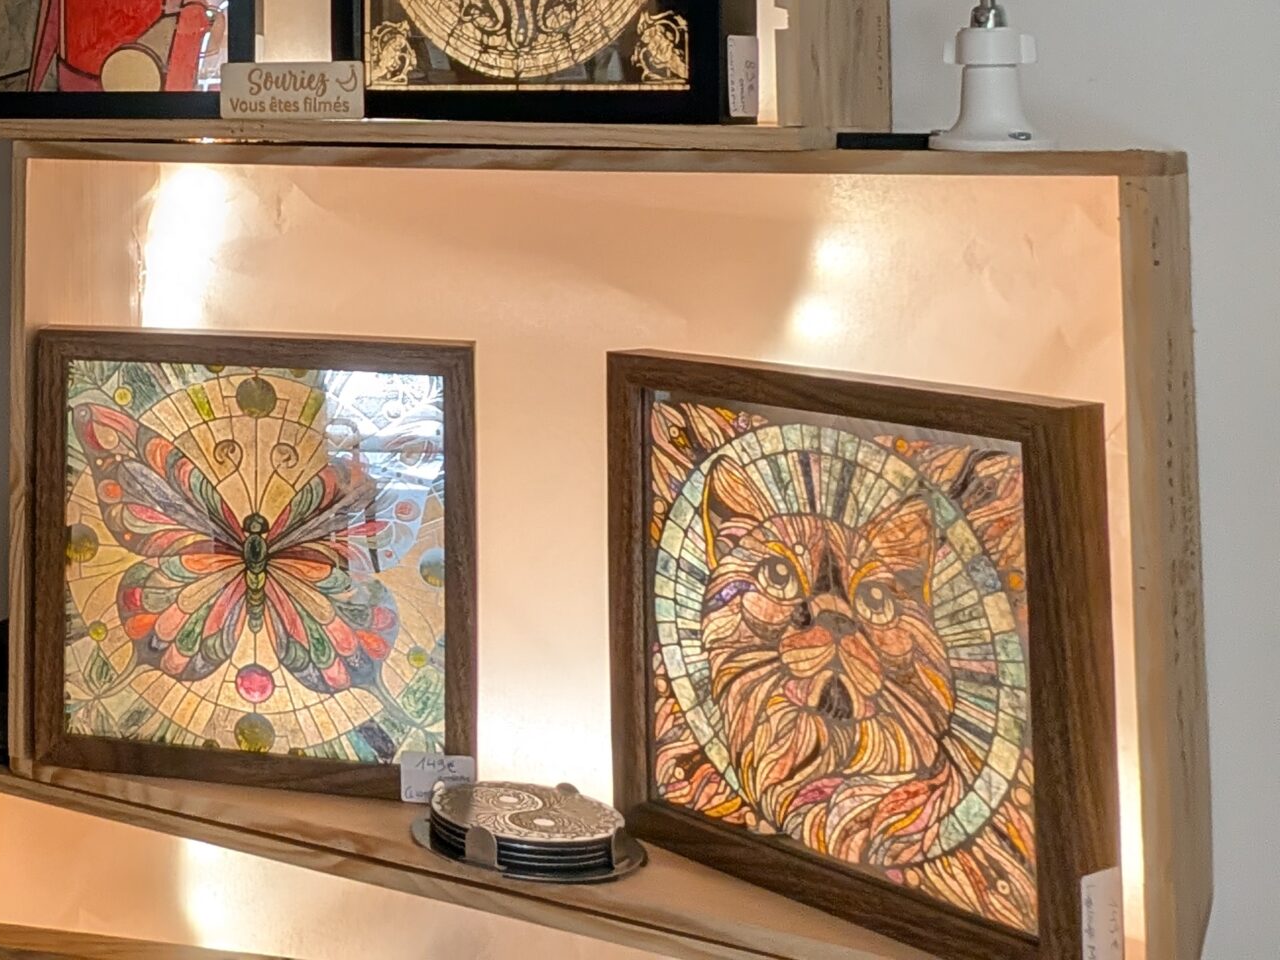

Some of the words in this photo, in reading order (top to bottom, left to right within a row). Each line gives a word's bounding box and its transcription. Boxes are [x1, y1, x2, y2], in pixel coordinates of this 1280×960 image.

[247, 68, 330, 97] Souriez
[229, 97, 266, 113] Vous
[269, 97, 300, 113] êtes
[303, 95, 350, 113] filmés
